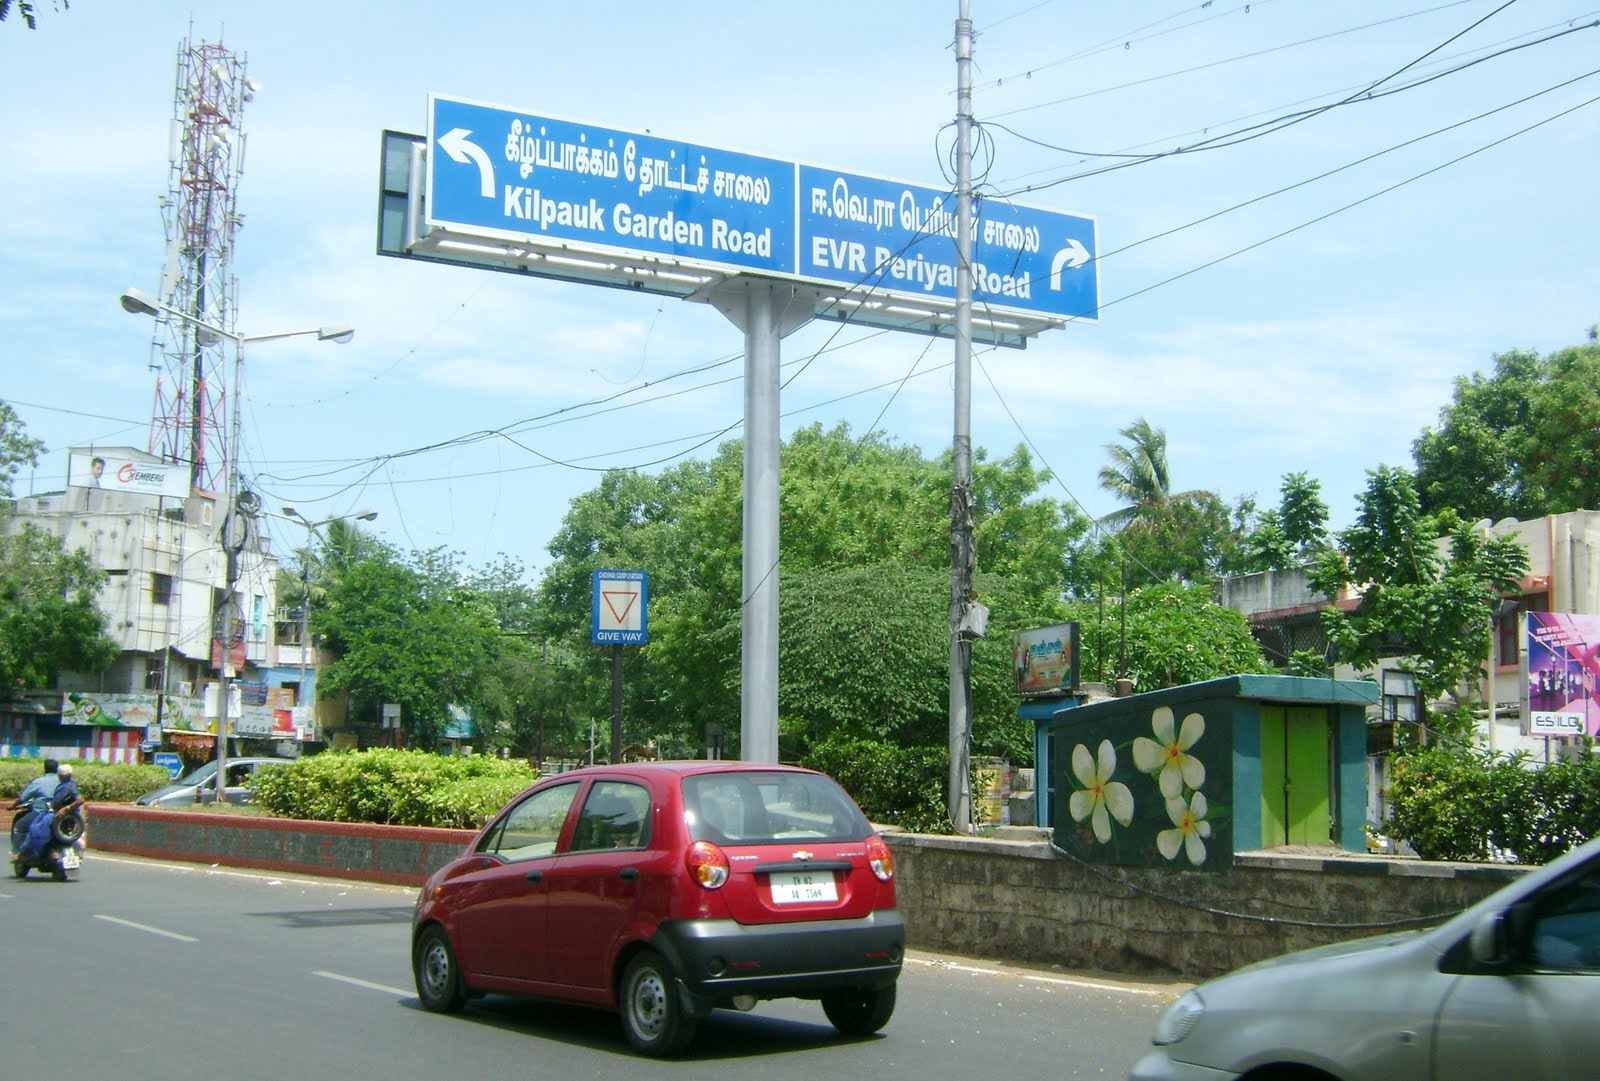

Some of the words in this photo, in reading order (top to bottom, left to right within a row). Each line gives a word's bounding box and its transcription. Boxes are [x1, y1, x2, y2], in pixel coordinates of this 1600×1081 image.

[505, 119, 619, 179] கீழ்ப்பாக்கம்
[623, 139, 710, 196] தோட்டச்
[713, 170, 771, 206] சாலை
[504, 185, 605, 231] Kilpauk
[613, 203, 703, 246] Garden
[712, 219, 771, 258] Road
[899, 189, 979, 242] பெரியர்
[983, 218, 1040, 254] சாலை
[812, 236, 866, 273] EVR
[971, 262, 1031, 299] Road
[597, 632, 620, 641] GIVE
[622, 632, 642, 641] WAY
